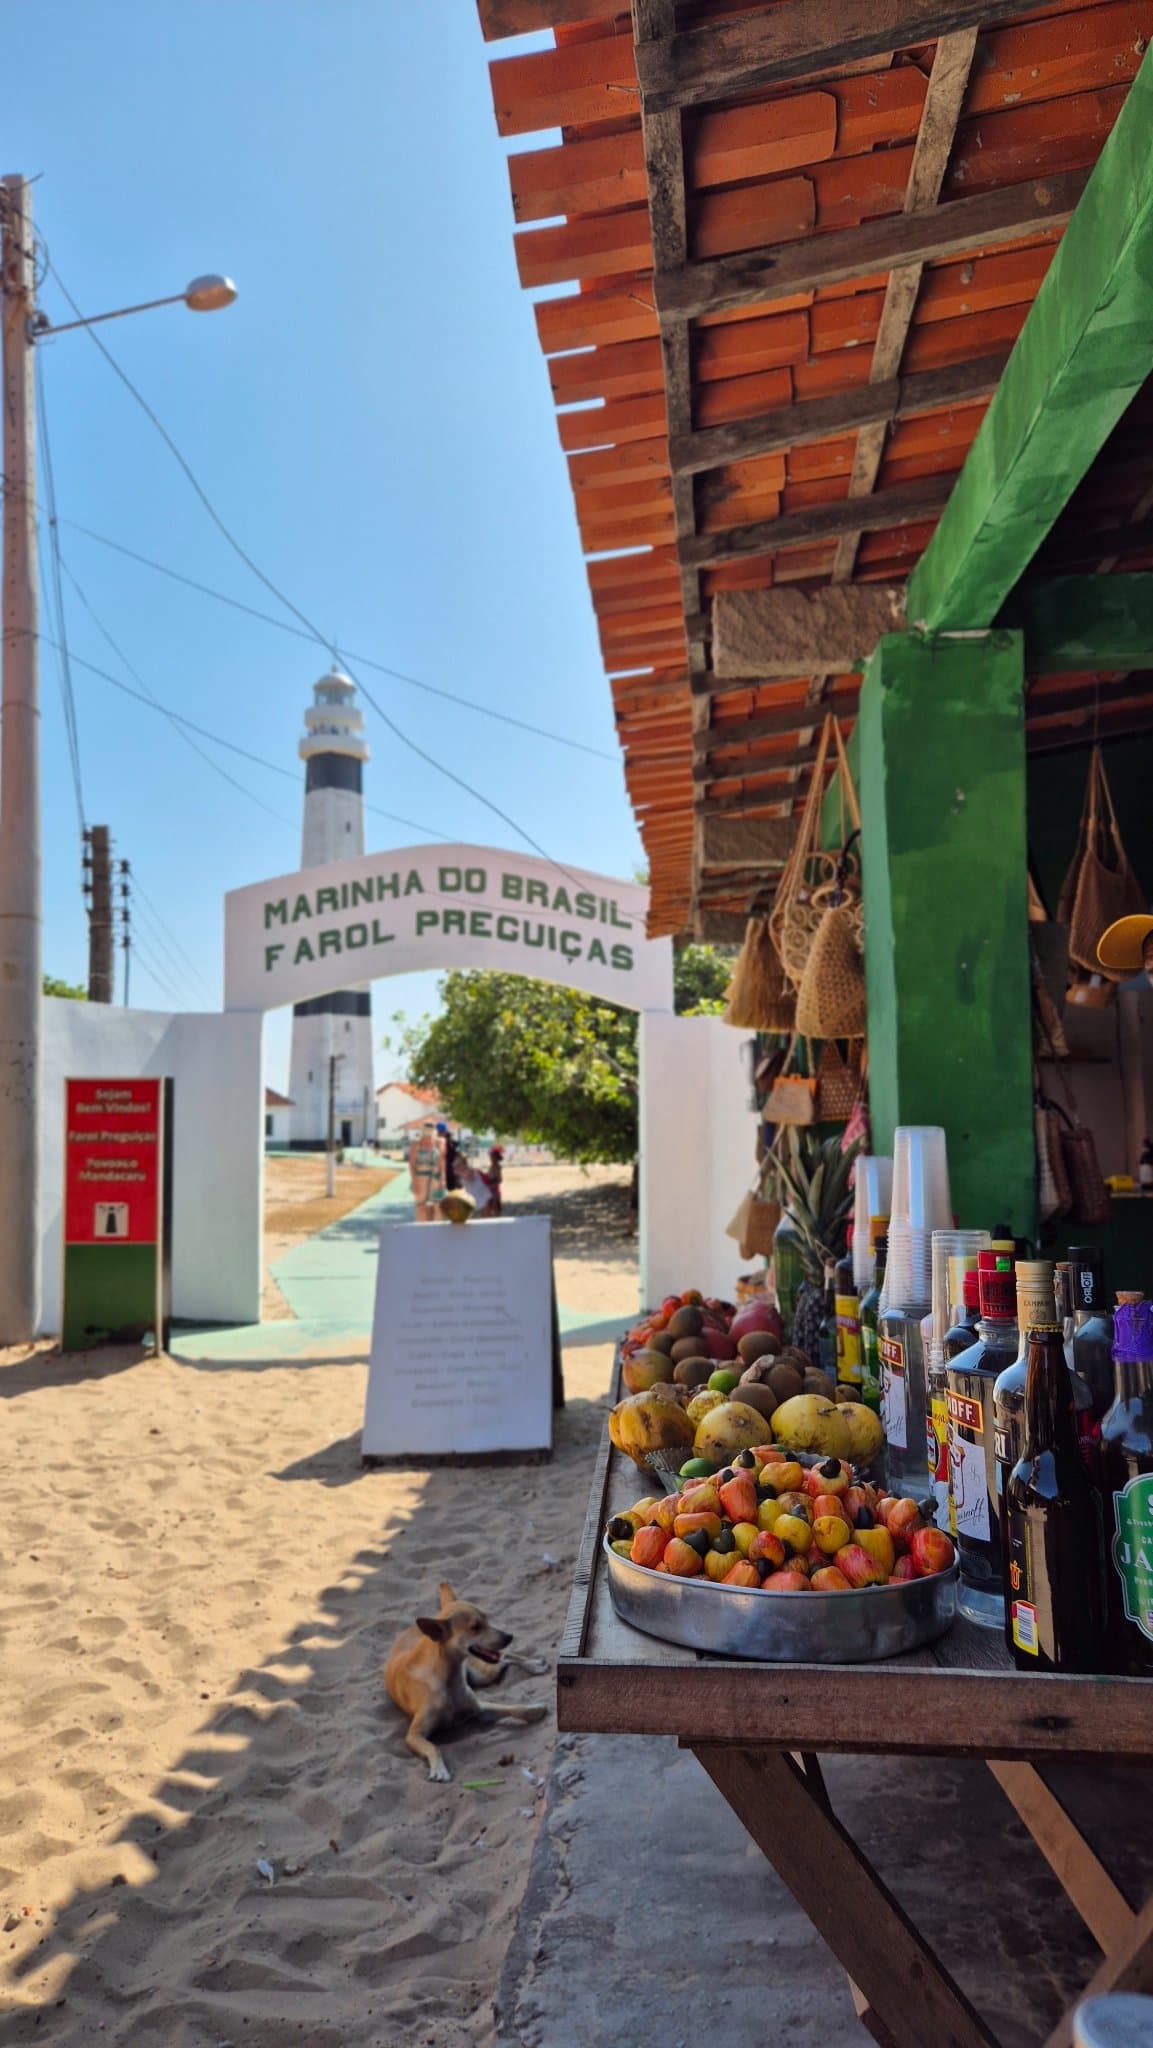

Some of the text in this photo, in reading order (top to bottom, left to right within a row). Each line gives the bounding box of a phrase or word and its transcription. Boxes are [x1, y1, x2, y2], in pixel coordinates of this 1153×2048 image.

[264, 866, 633, 930] MARINHA DO BRASIL
[265, 909, 634, 972] FAROL PREGUIÇAS
[75, 1102, 103, 1113] Bem
[96, 1088, 132, 1101] Sejam
